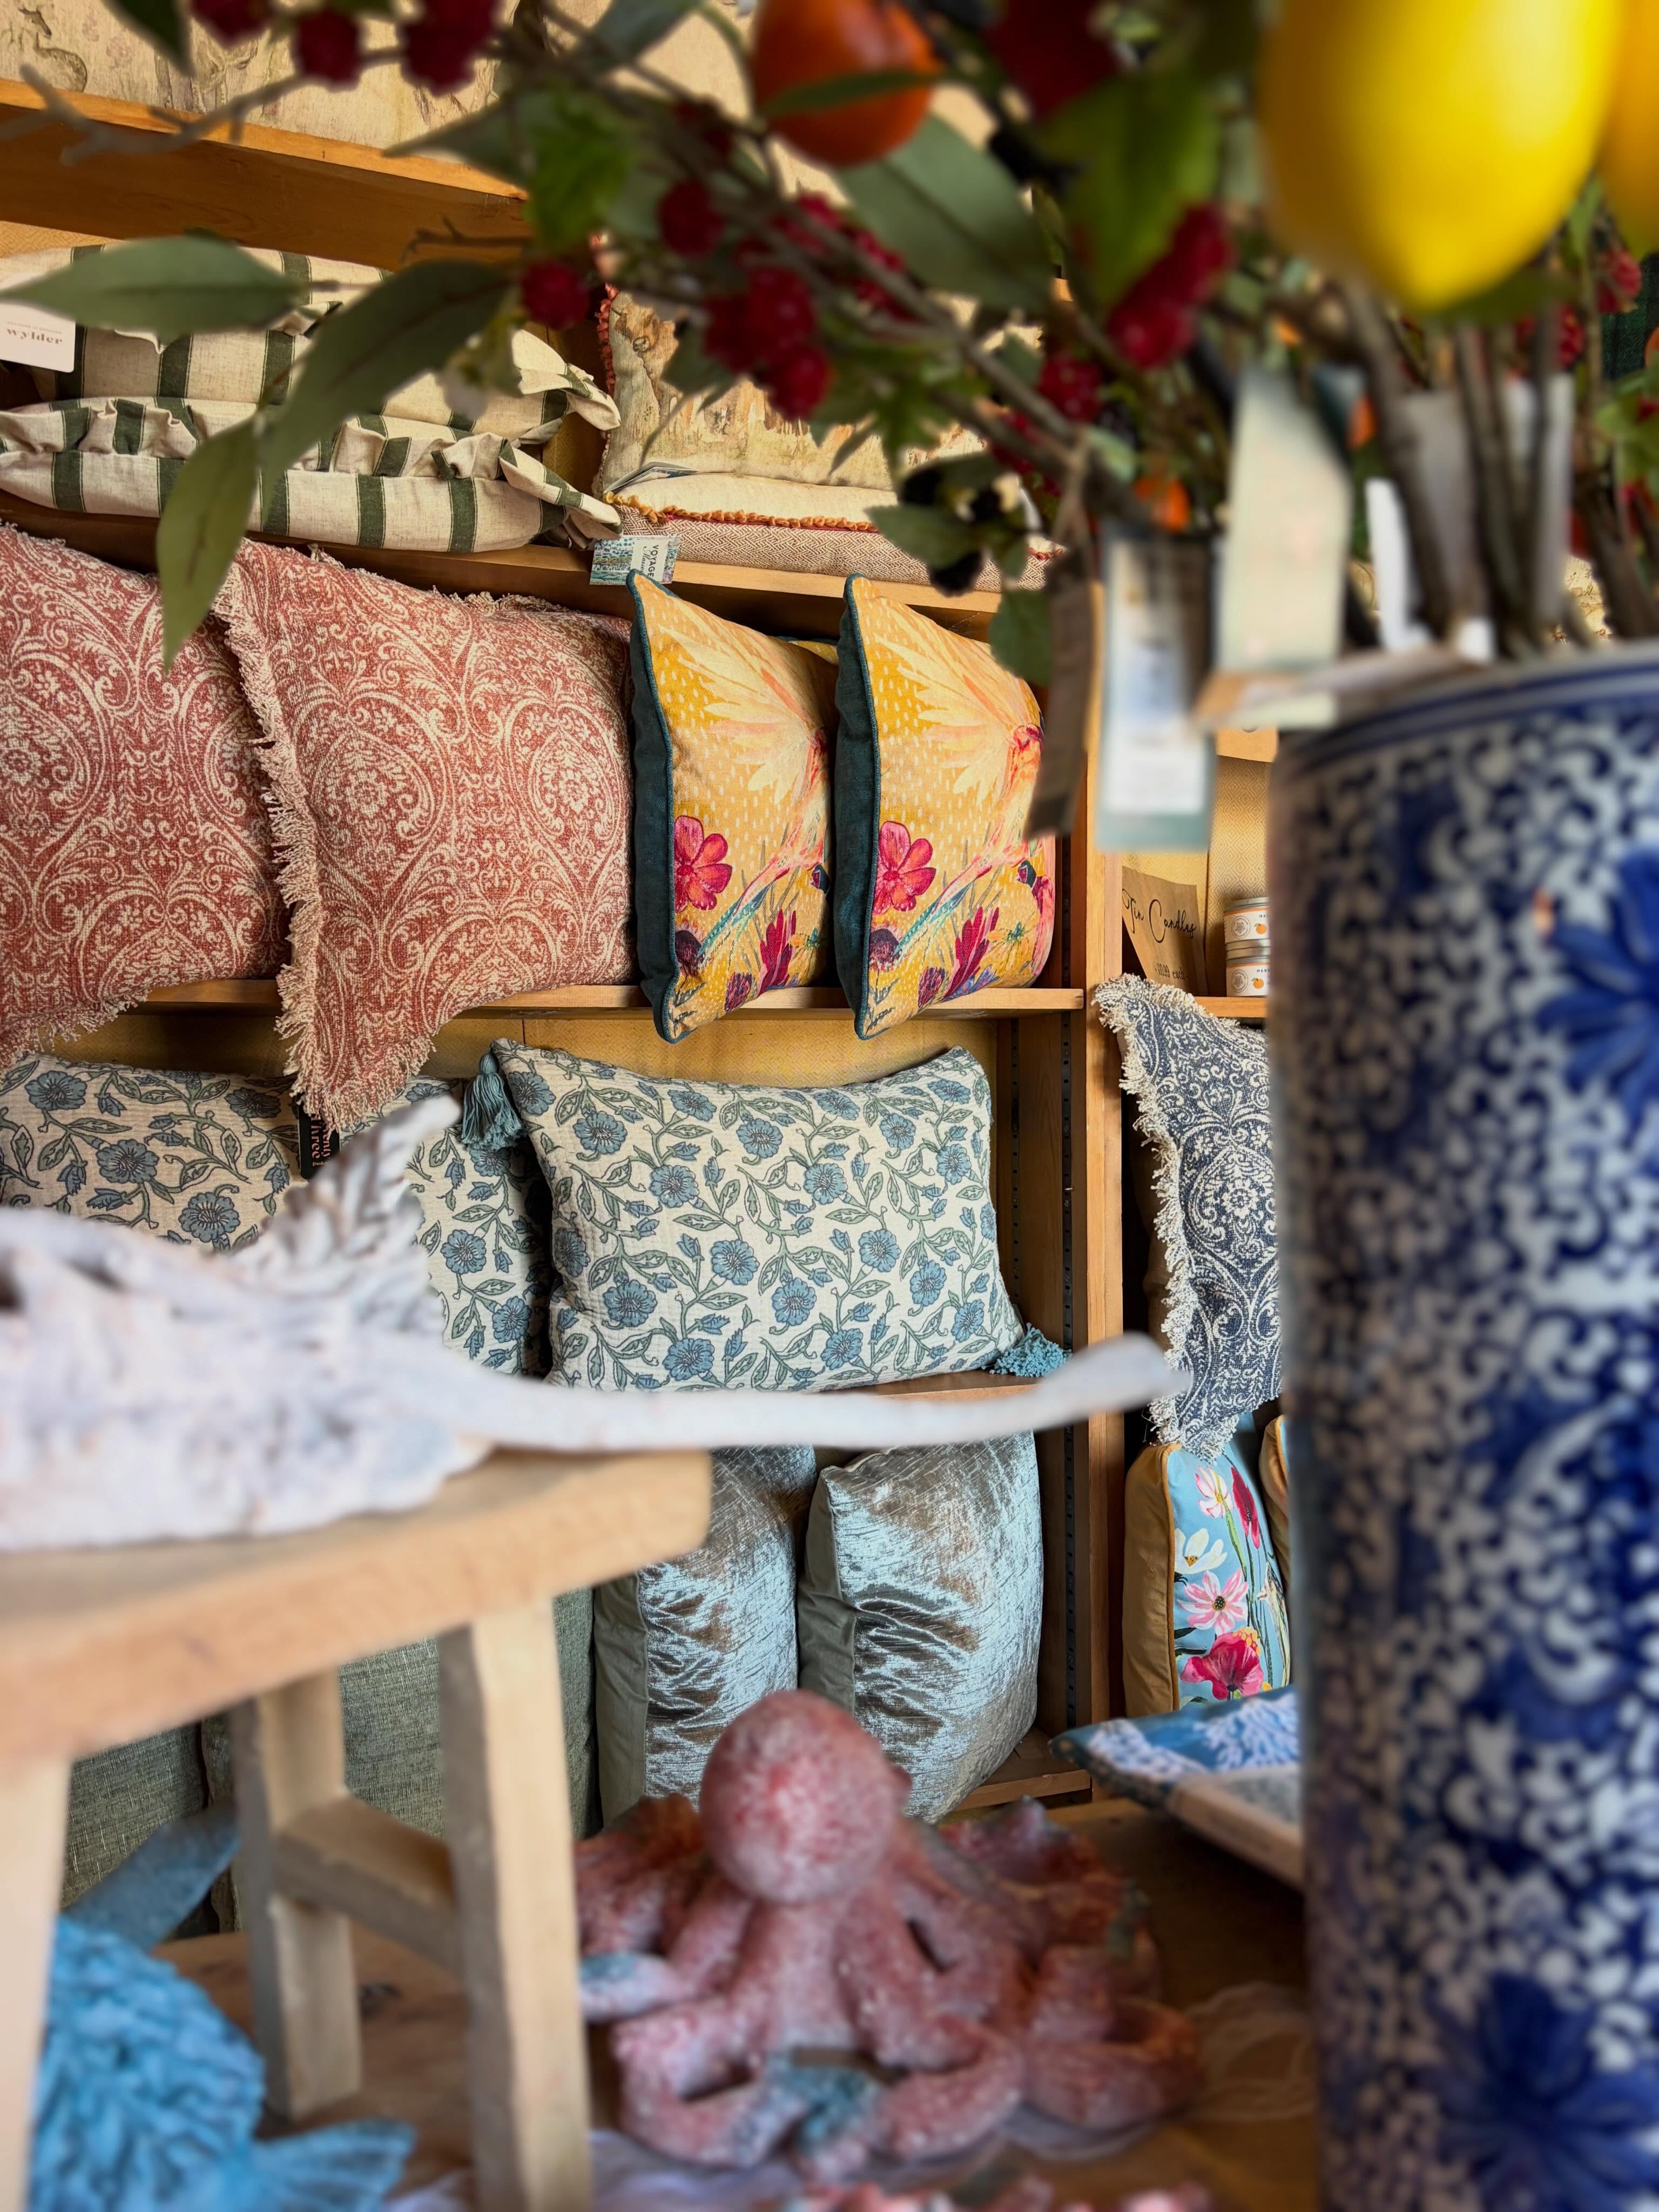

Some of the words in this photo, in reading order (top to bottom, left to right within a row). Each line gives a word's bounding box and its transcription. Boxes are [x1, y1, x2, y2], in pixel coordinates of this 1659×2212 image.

[6, 328, 63, 344] wylder
[648, 544, 659, 577] VOYAGE
[1122, 888, 1144, 934] Tin
[1149, 899, 1197, 943] Candles
[1172, 967, 1185, 981] each
